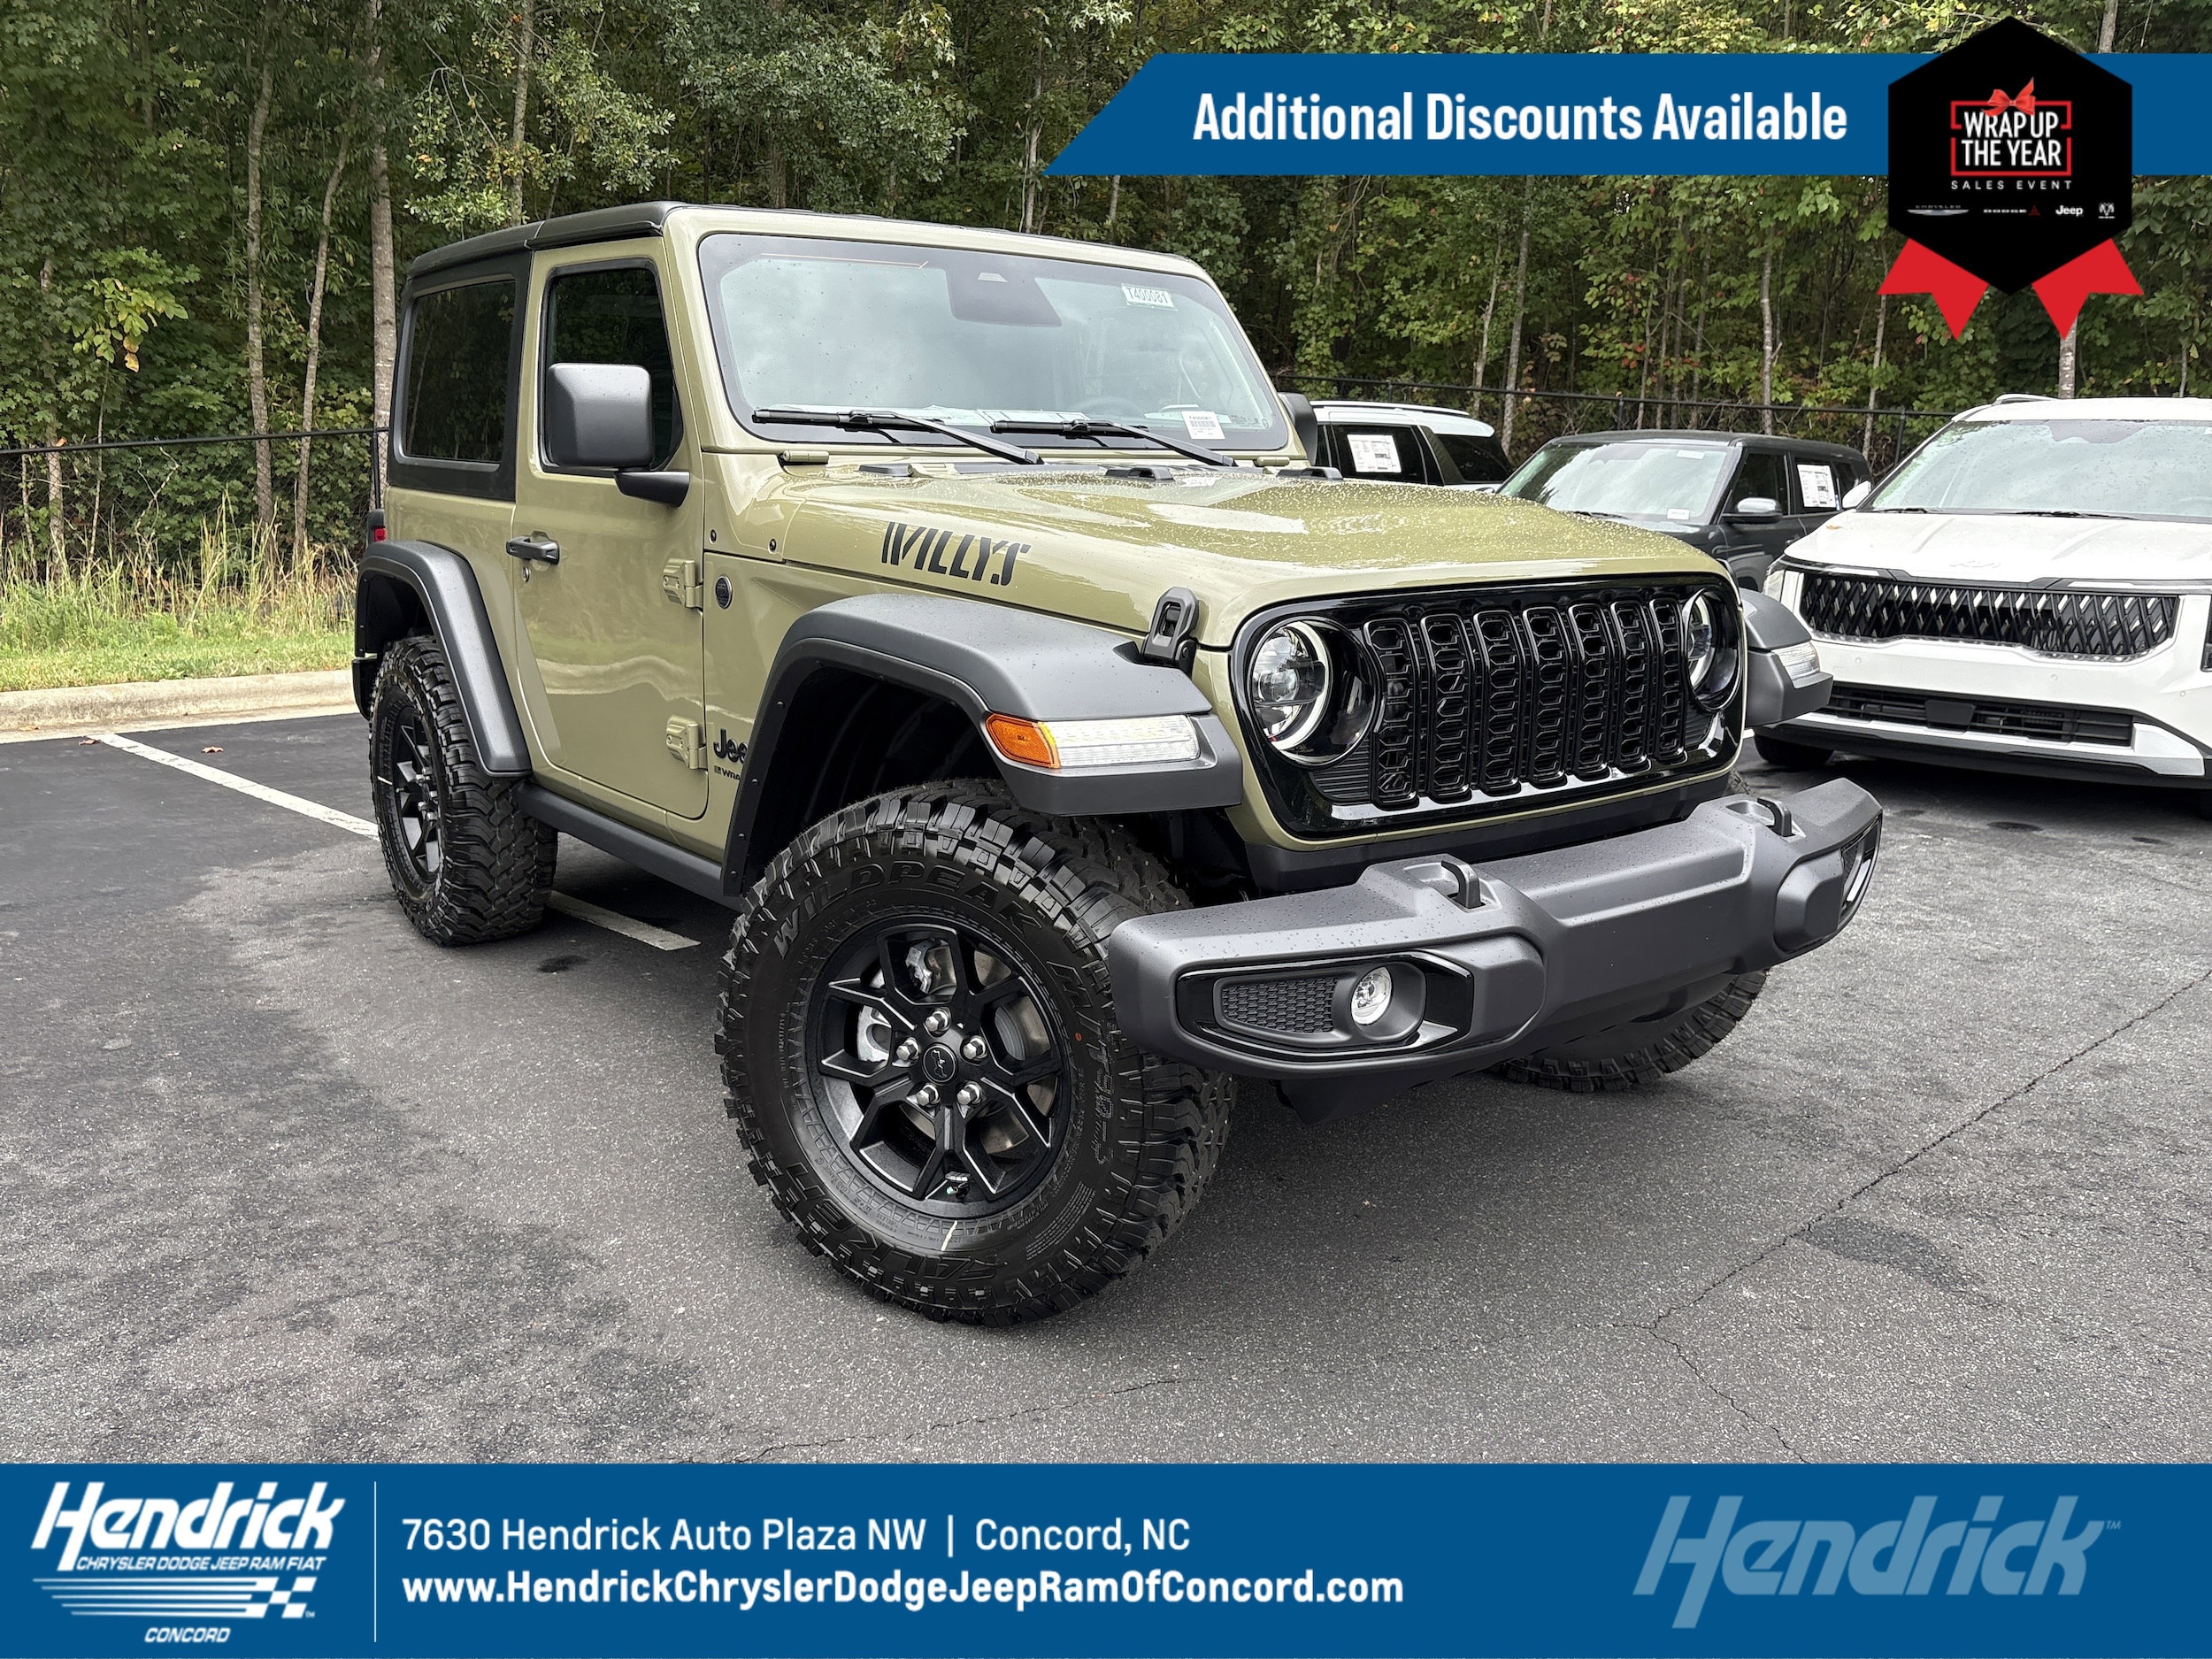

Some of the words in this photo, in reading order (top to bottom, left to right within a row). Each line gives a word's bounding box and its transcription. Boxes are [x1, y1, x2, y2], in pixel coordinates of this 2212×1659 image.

[881, 521, 1033, 587] WILLYS
[713, 728, 748, 765] Jee
[773, 860, 1042, 960] WILDPEAK
